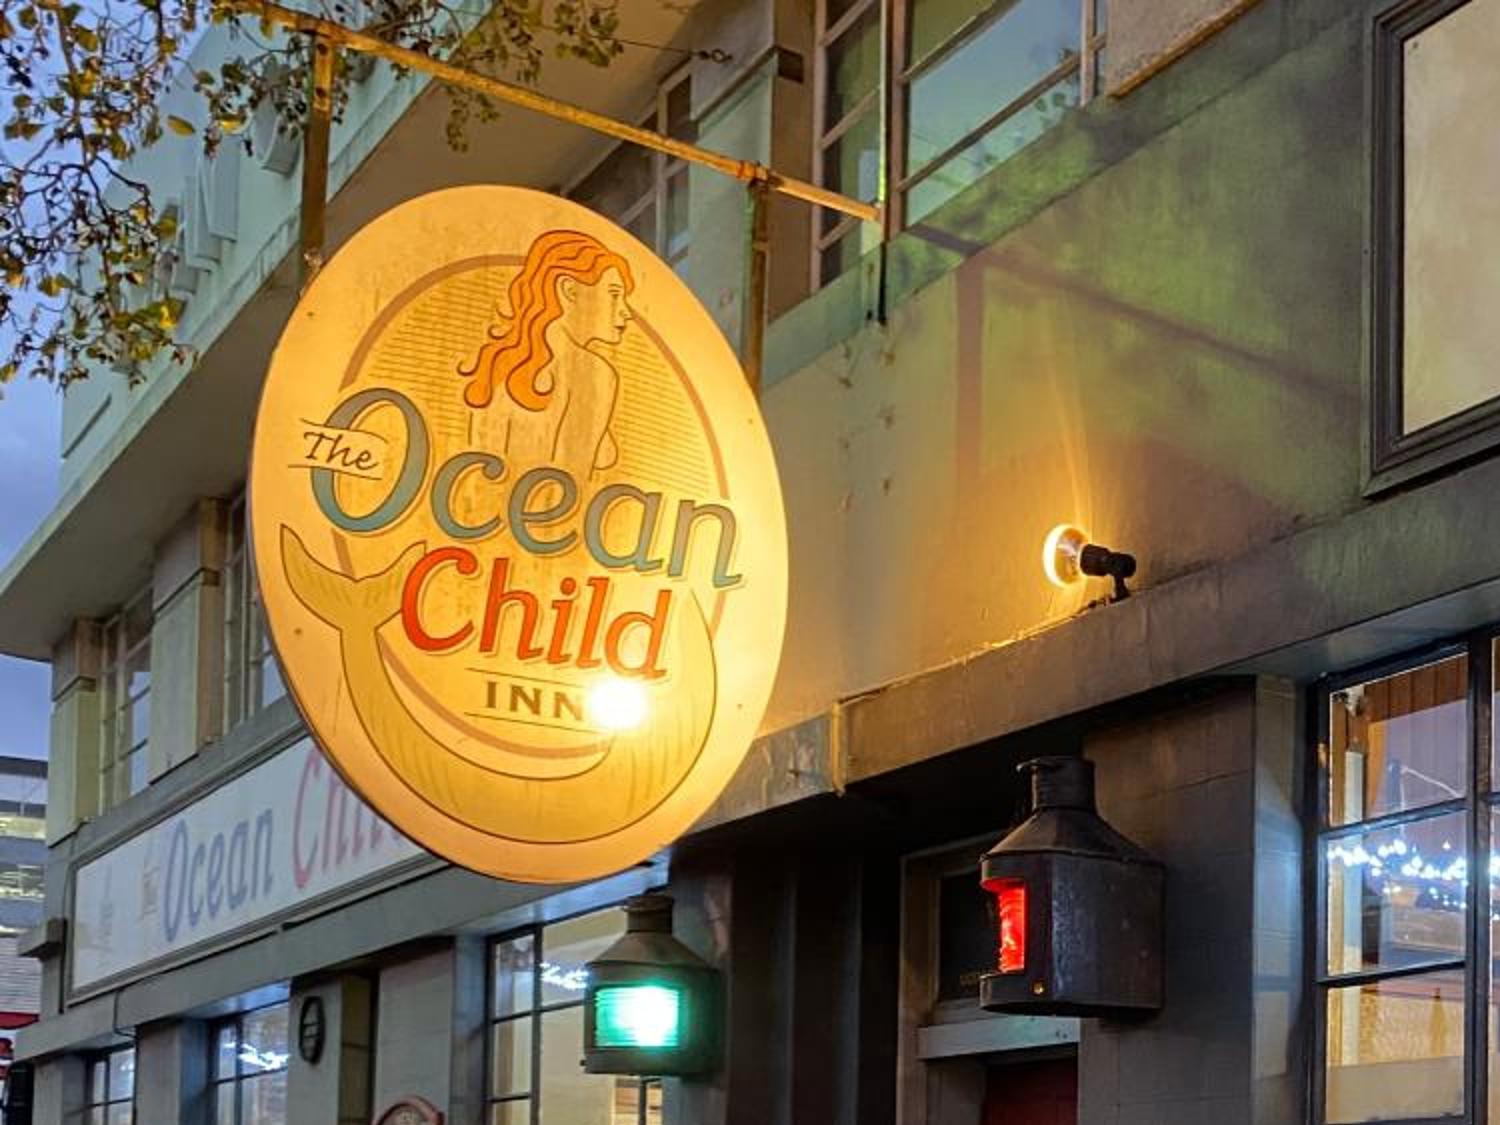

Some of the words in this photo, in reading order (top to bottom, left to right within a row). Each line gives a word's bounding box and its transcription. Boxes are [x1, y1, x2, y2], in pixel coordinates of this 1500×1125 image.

[303, 430, 379, 472] The
[310, 387, 743, 589] Ocean
[400, 547, 674, 680] Child
[484, 680, 584, 723] INN
[162, 808, 273, 943] Ocean
